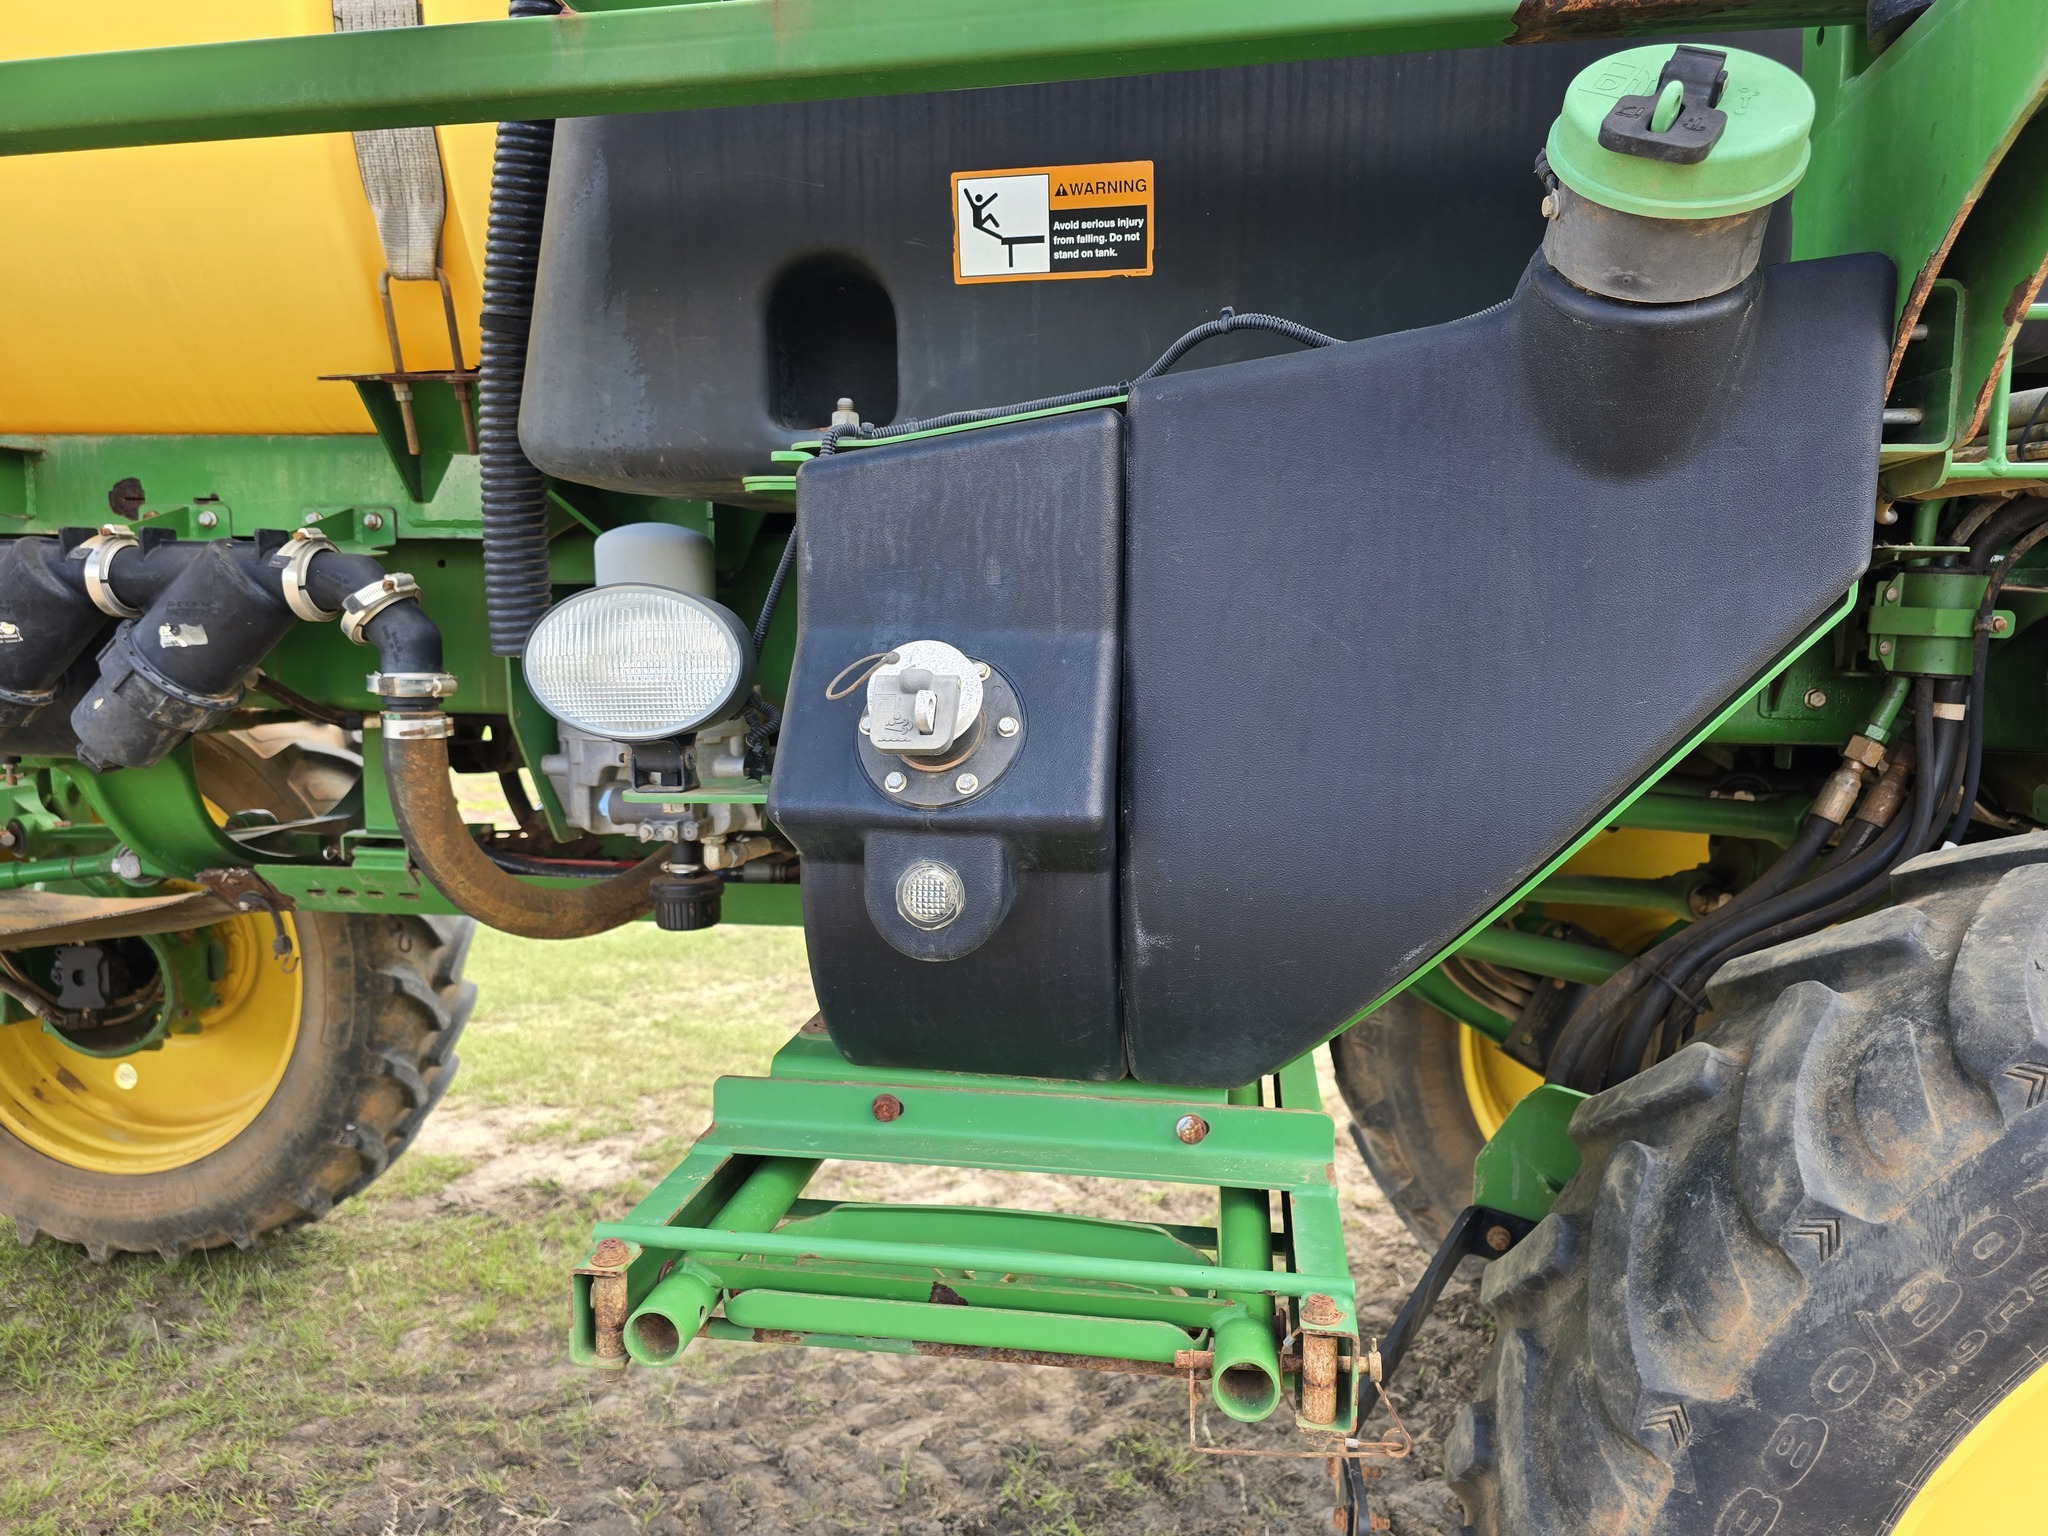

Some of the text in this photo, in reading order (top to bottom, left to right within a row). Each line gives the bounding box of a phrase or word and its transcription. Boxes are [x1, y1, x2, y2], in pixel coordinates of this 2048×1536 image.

[1069, 178, 1147, 196] WARNING
[1053, 217, 1144, 231] Avoid serious injury
[1053, 232, 1140, 245] from falling. Do not
[1053, 247, 1118, 260] stand on tank.
